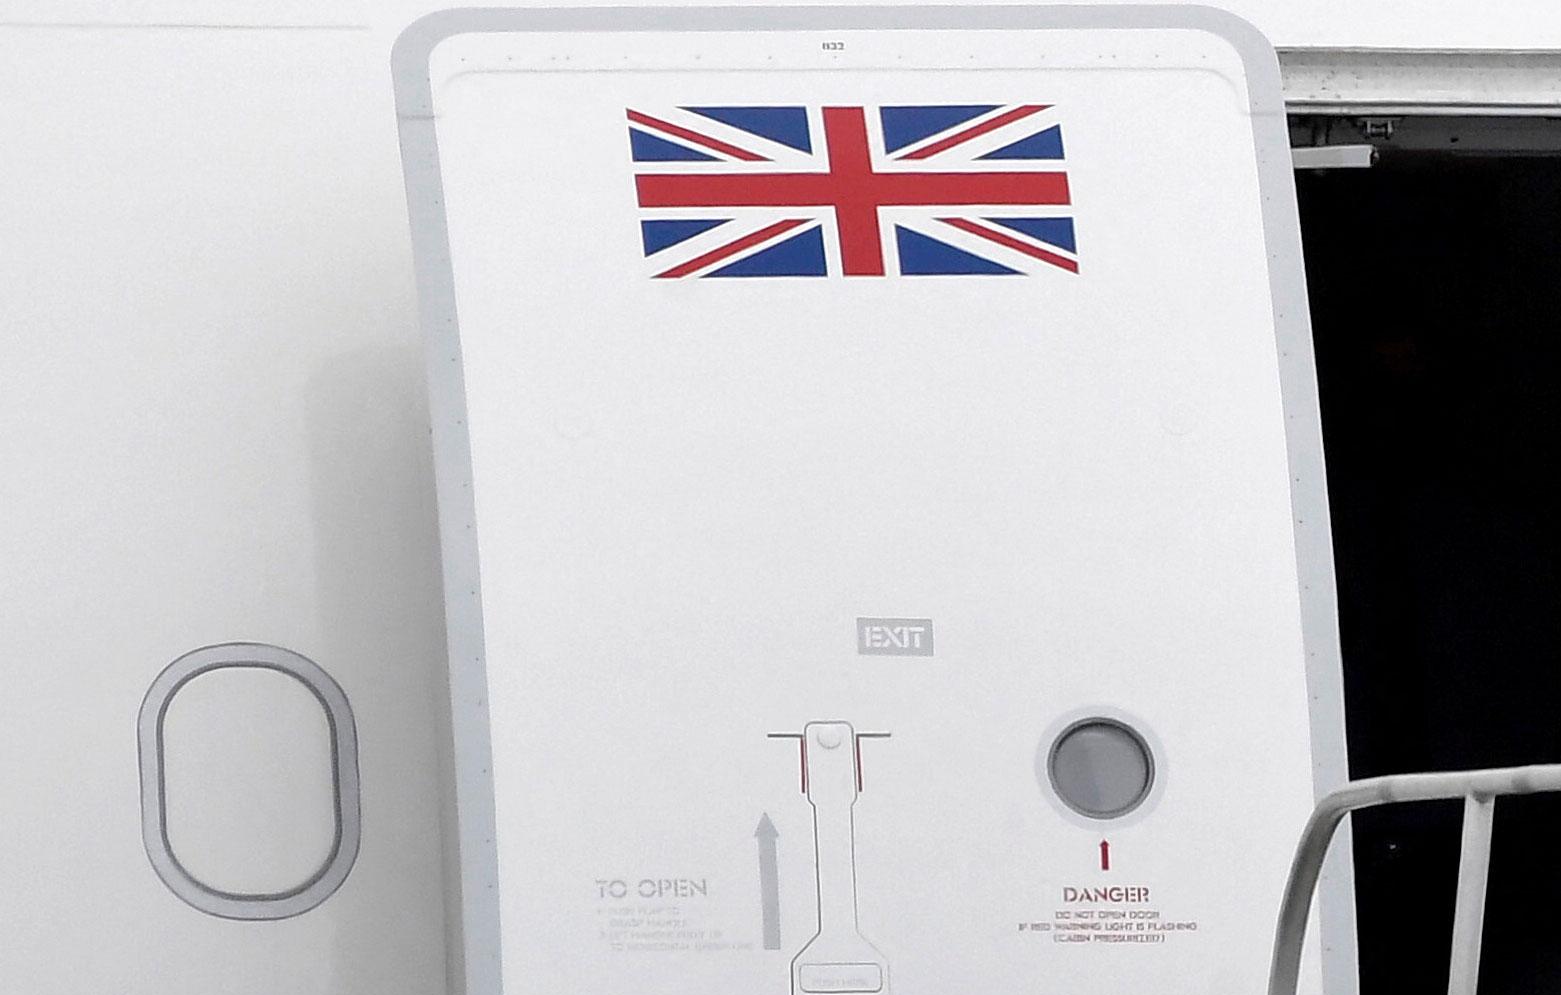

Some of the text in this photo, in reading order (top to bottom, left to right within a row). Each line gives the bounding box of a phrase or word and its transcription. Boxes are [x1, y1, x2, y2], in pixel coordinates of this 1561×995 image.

[864, 626, 925, 648] EXIT
[595, 877, 708, 899] TO OPEN
[1063, 886, 1150, 903] DANGER
[1055, 910, 1160, 920] DO NOT OPEN DOOR
[1104, 922, 1133, 931] LIGHT
[1147, 922, 1198, 931] FLASHING
